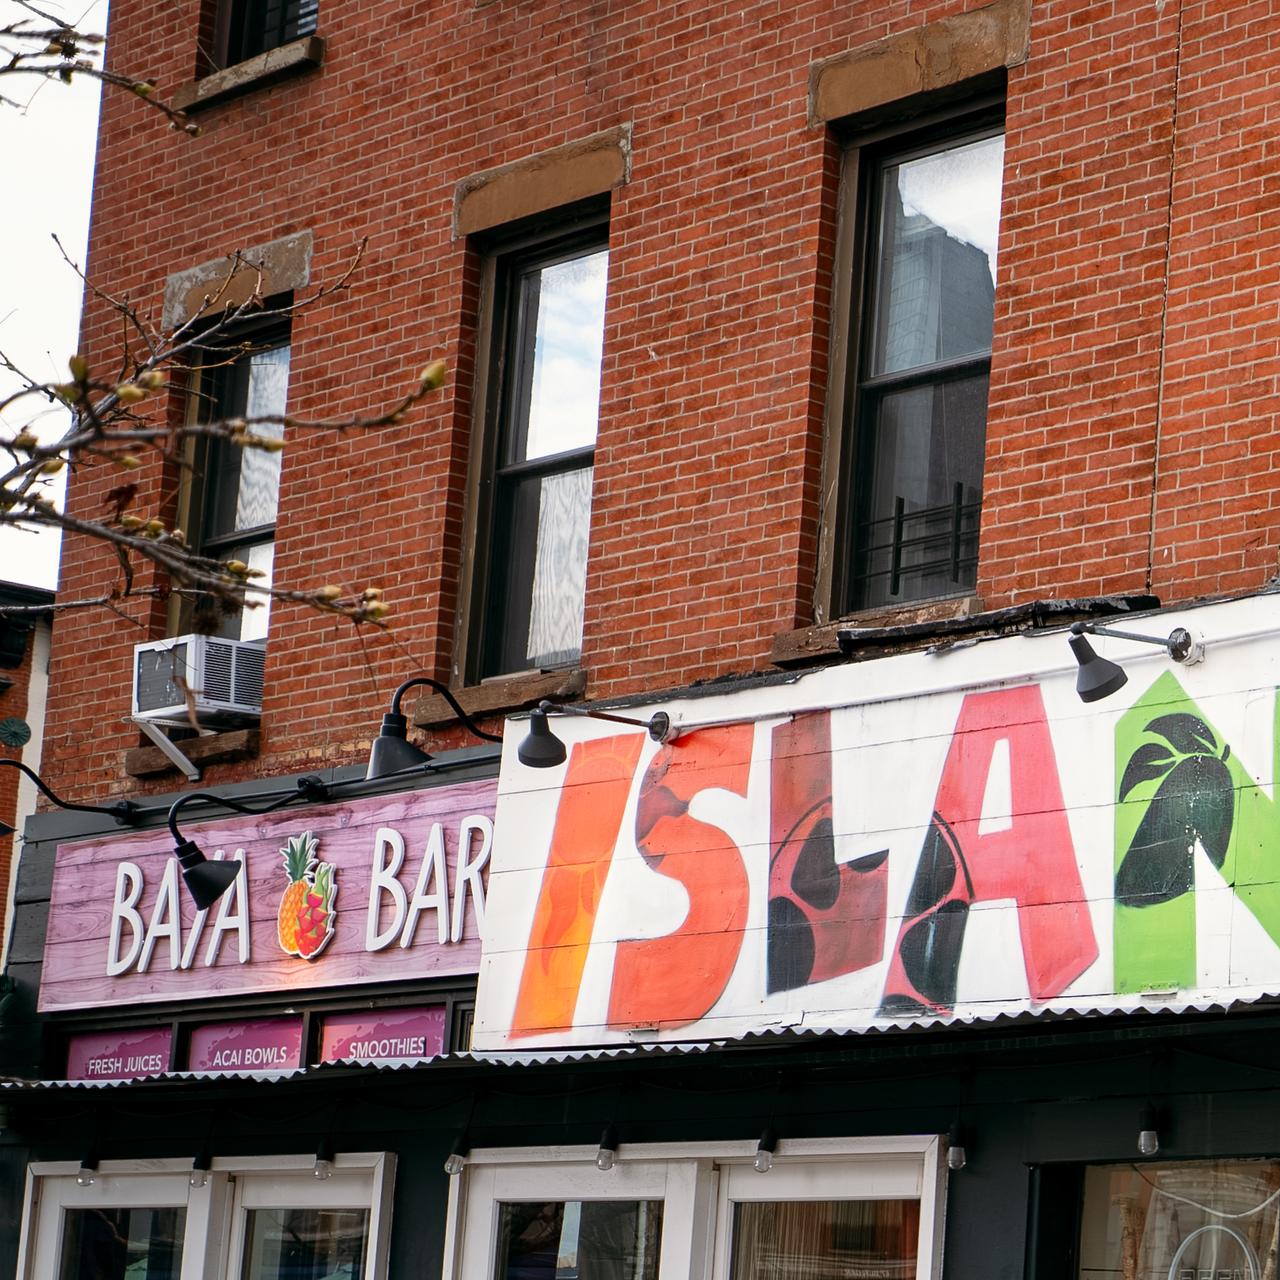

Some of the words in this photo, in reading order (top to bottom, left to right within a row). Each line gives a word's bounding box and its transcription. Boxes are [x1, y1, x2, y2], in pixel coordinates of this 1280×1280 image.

[365, 814, 495, 953] BAR
[213, 1048, 243, 1067] ACAI
[244, 1046, 288, 1066] BOWLS
[349, 1036, 426, 1059] SMOOTHIES
[88, 1057, 123, 1075] FRESH
[123, 1054, 163, 1074] JUICES
